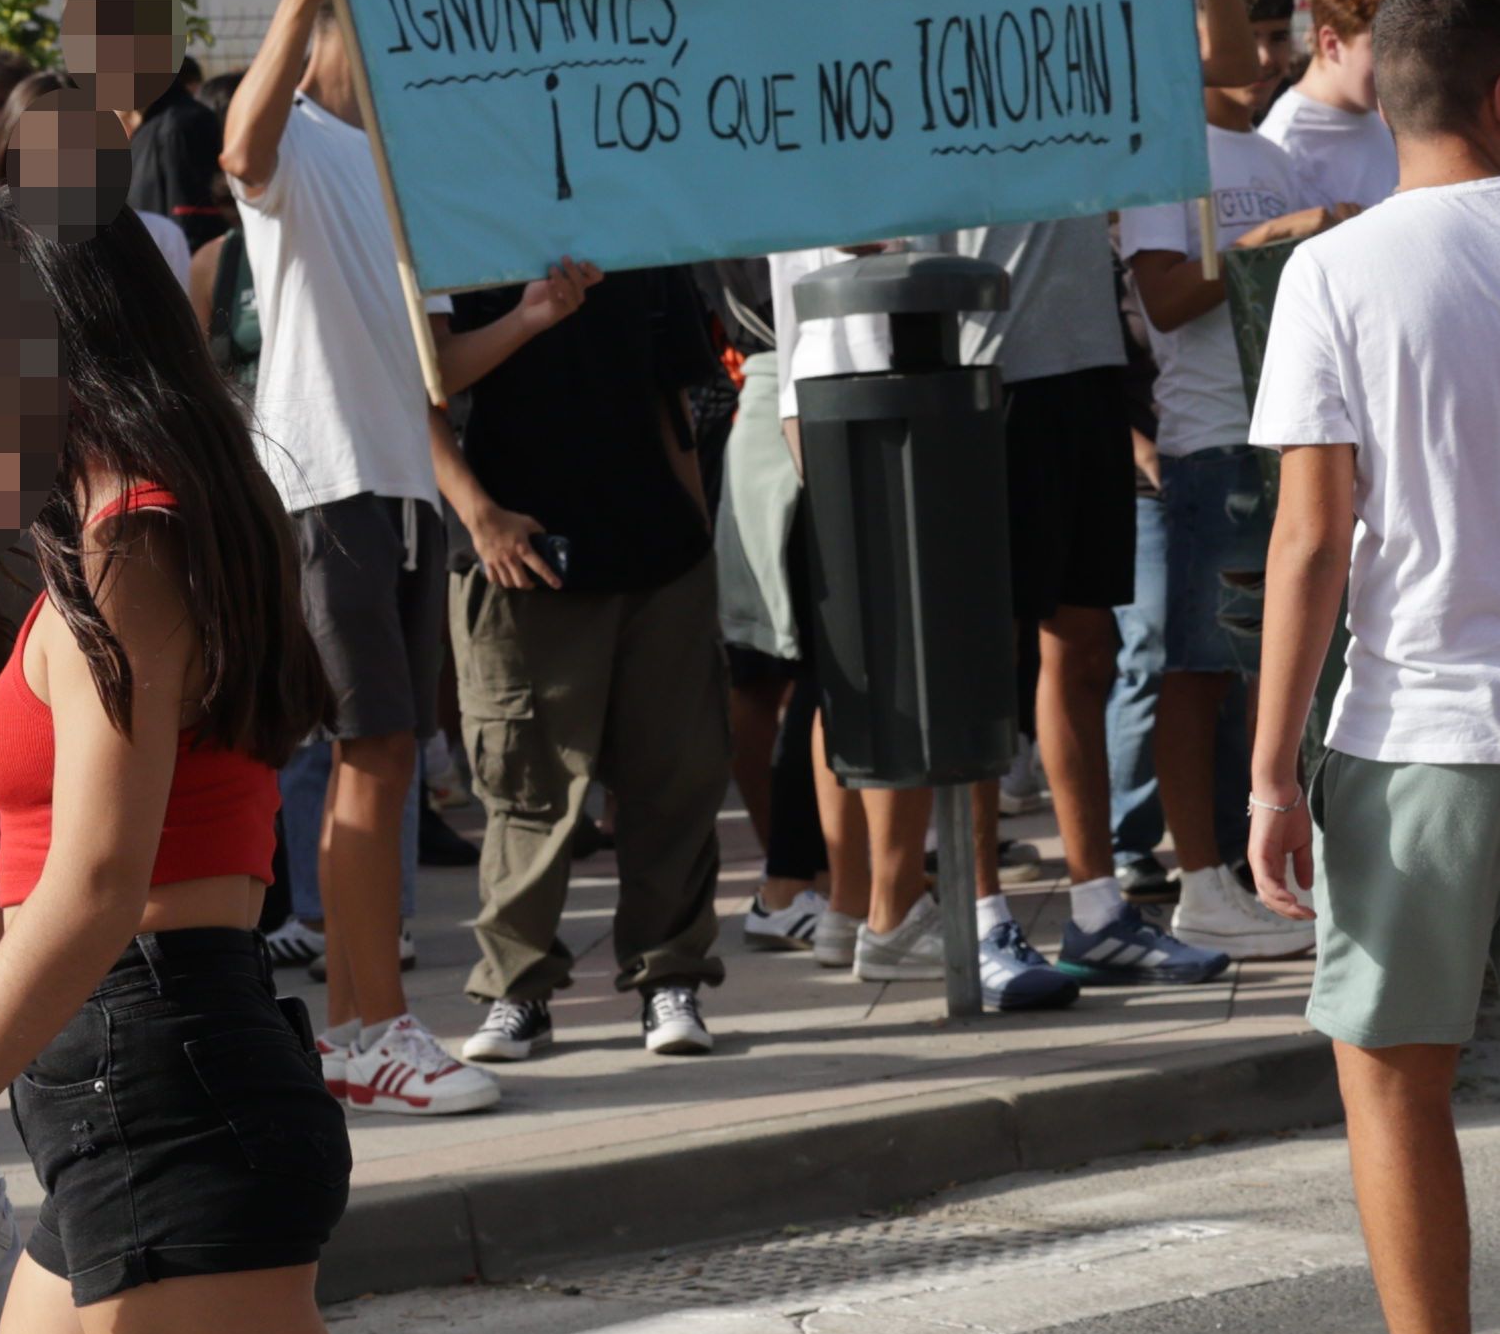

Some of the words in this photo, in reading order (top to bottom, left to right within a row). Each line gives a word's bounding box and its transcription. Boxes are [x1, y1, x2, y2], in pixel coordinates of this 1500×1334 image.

[707, 73, 803, 151] QUE
[819, 58, 894, 145] NOS
[913, 0, 1143, 156] IGNORAN!
